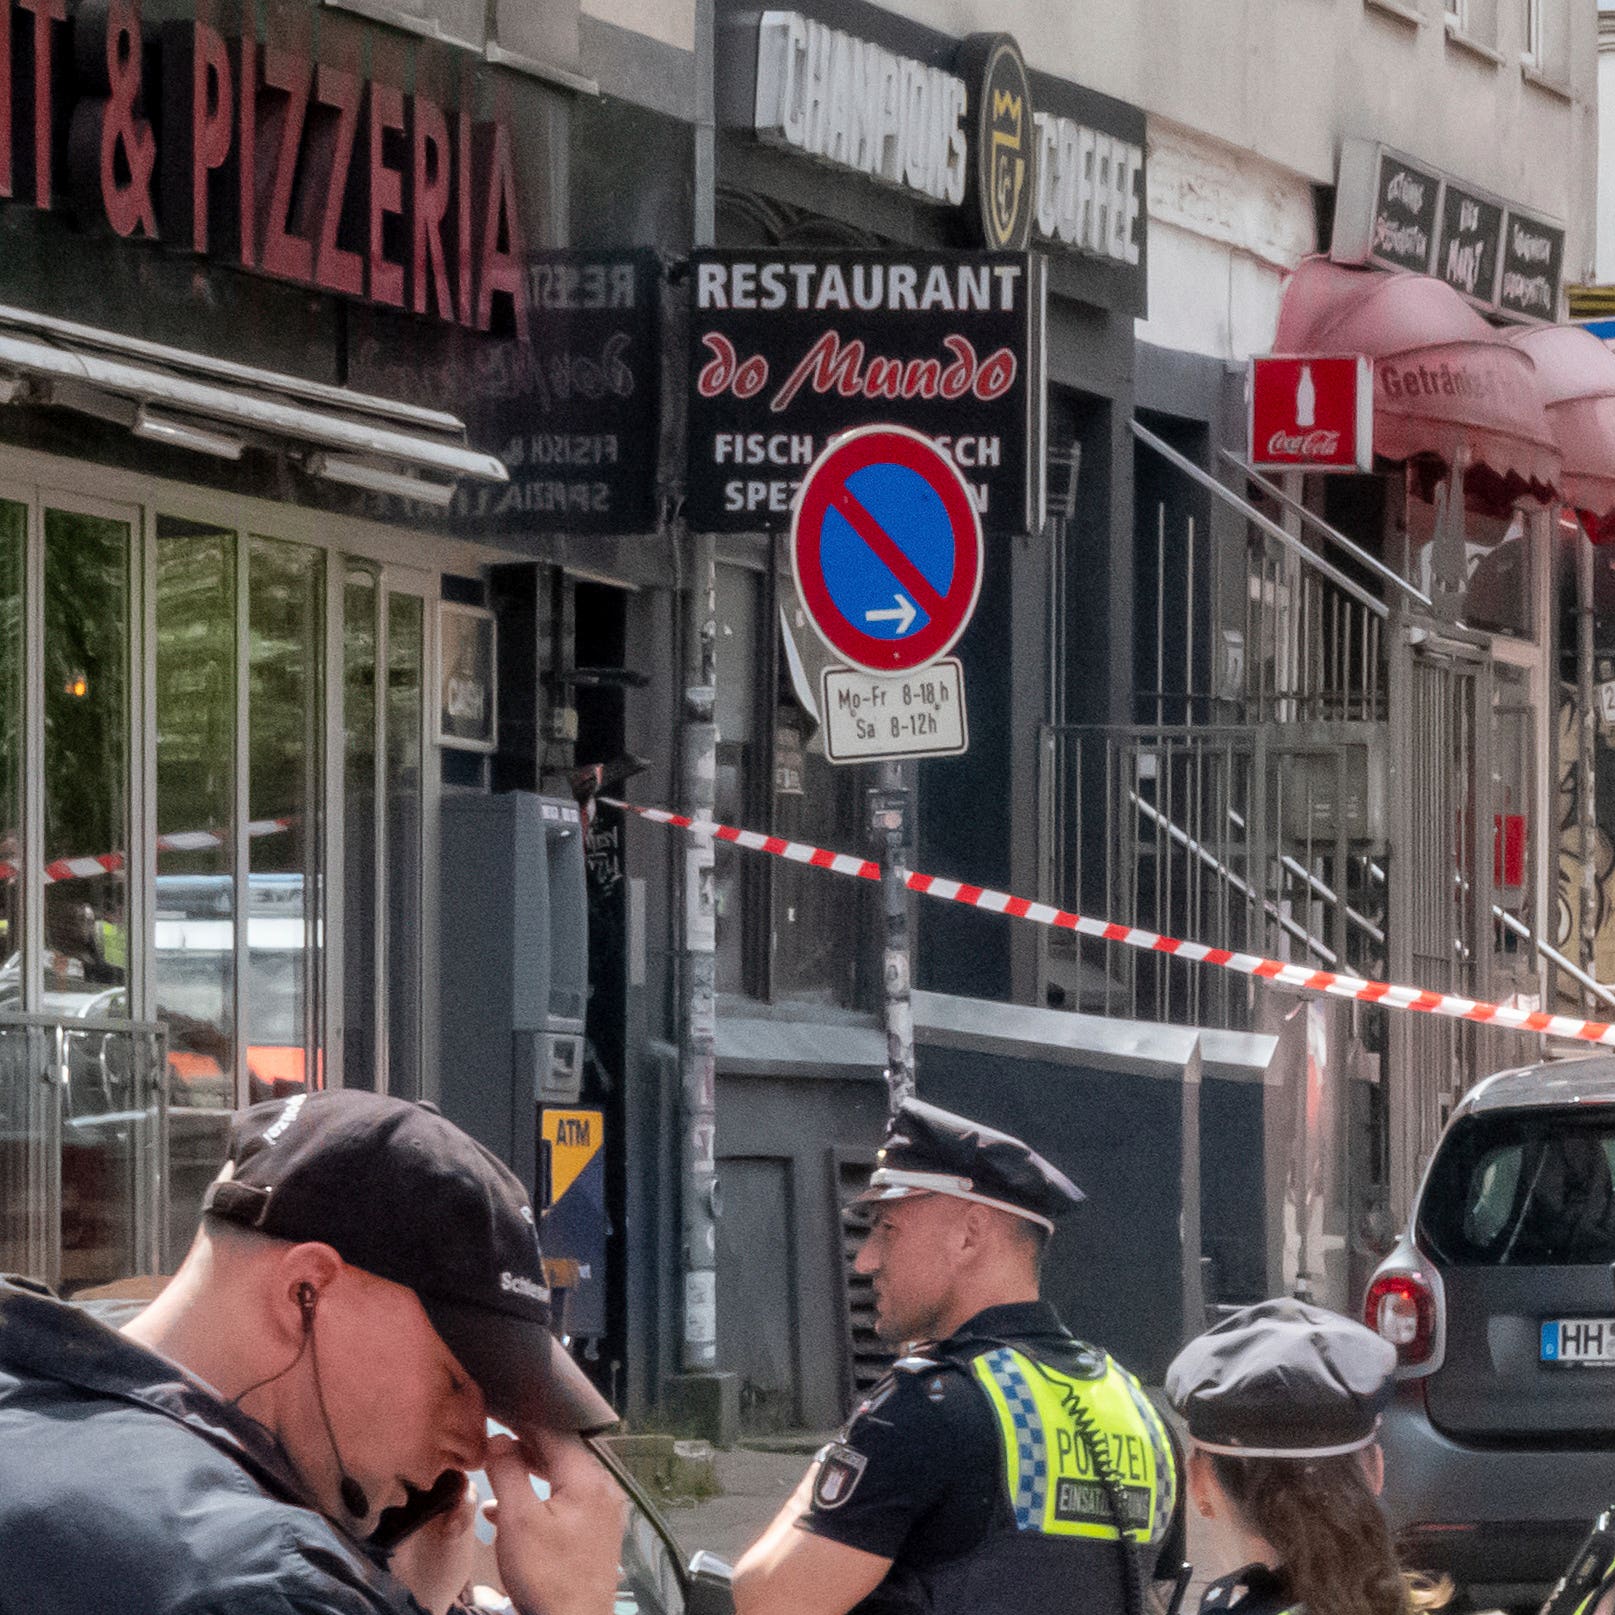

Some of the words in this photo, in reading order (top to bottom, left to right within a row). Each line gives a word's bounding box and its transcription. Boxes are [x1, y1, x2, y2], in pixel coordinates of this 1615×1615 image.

[193, 20, 530, 341] PIZZERIA
[698, 263, 1021, 311] RESTAURANT
[698, 331, 768, 399] do
[770, 329, 1017, 414] Mundo
[714, 433, 813, 465] FISCH
[838, 684, 888, 710] Mo-Fr
[902, 685, 936, 705] 8-18
[856, 718, 876, 739] Sa
[556, 1118, 591, 1148] ATM
[1561, 1323, 1604, 1356] HH
